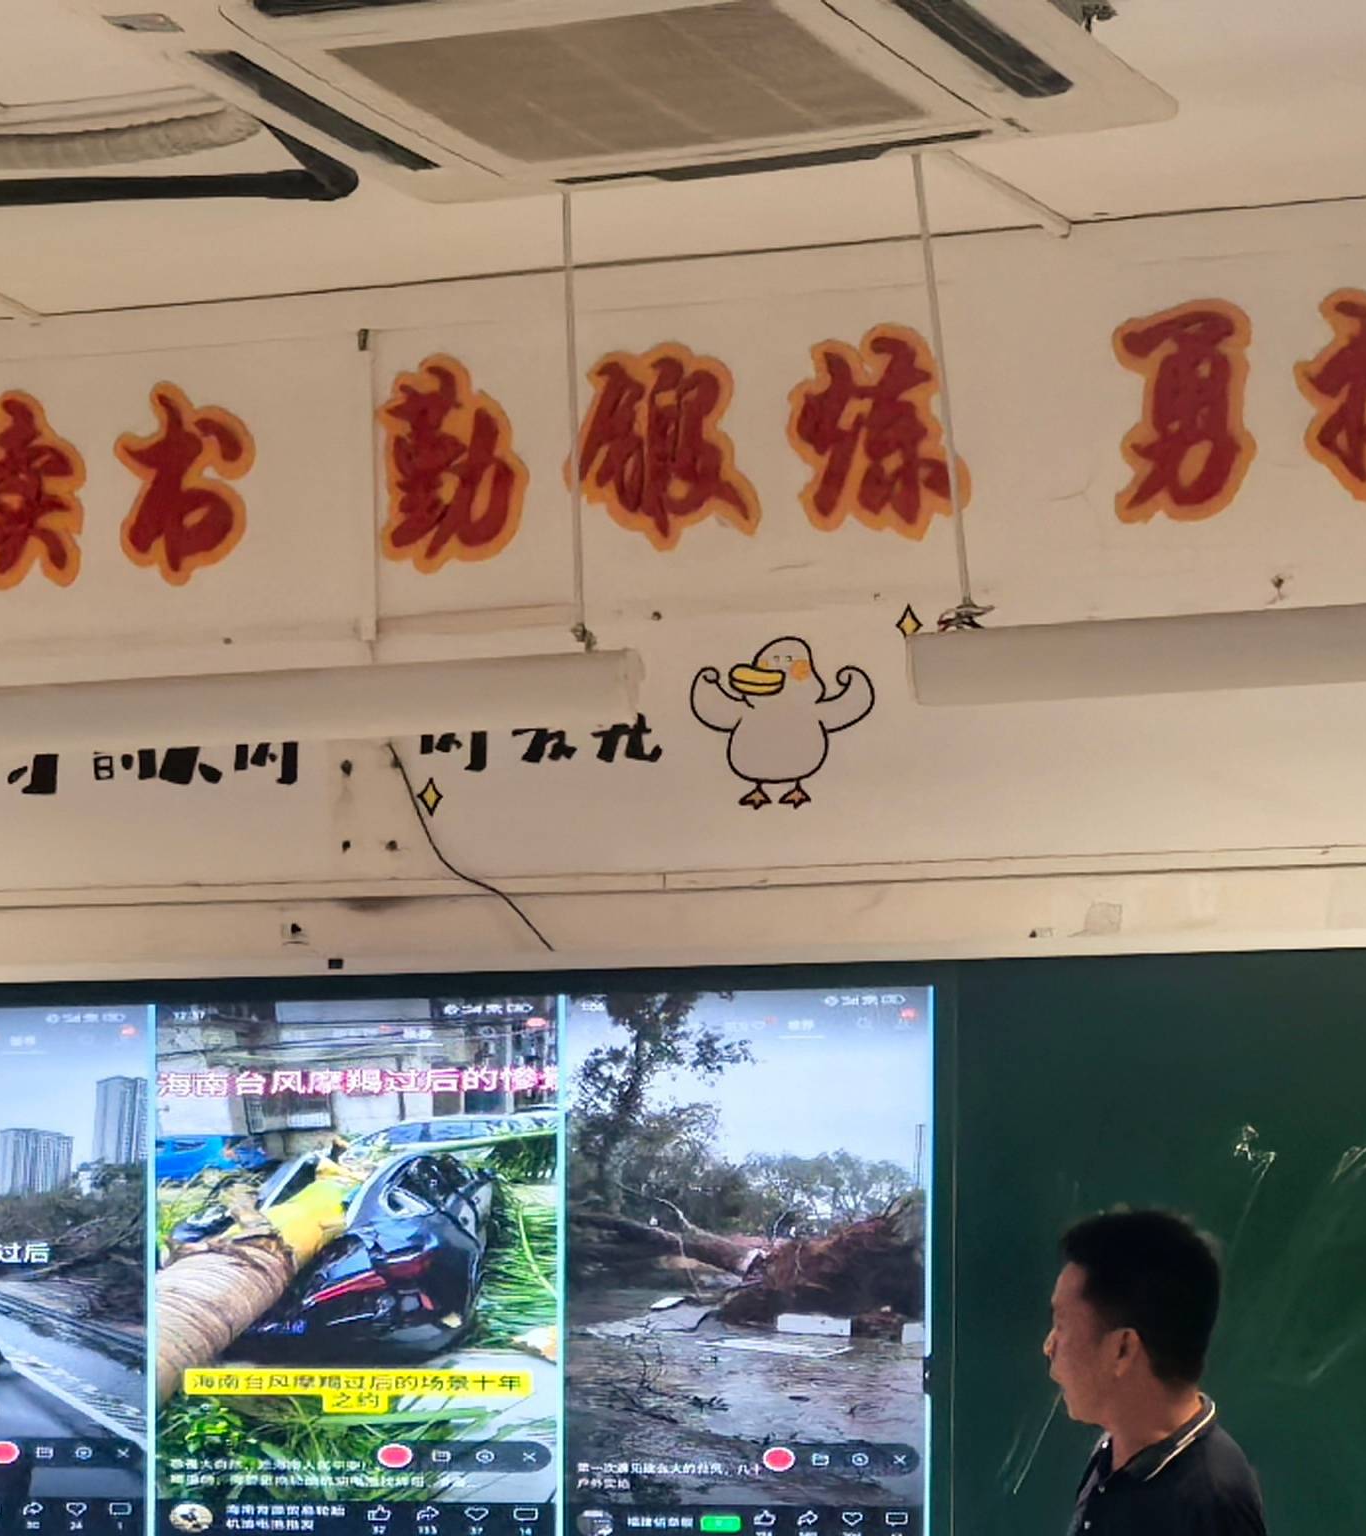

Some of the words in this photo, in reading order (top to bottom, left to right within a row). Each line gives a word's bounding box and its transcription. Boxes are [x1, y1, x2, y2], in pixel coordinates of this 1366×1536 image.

[376, 323, 970, 573] 勤锻炼
[331, 1392, 380, 1409] 之约
